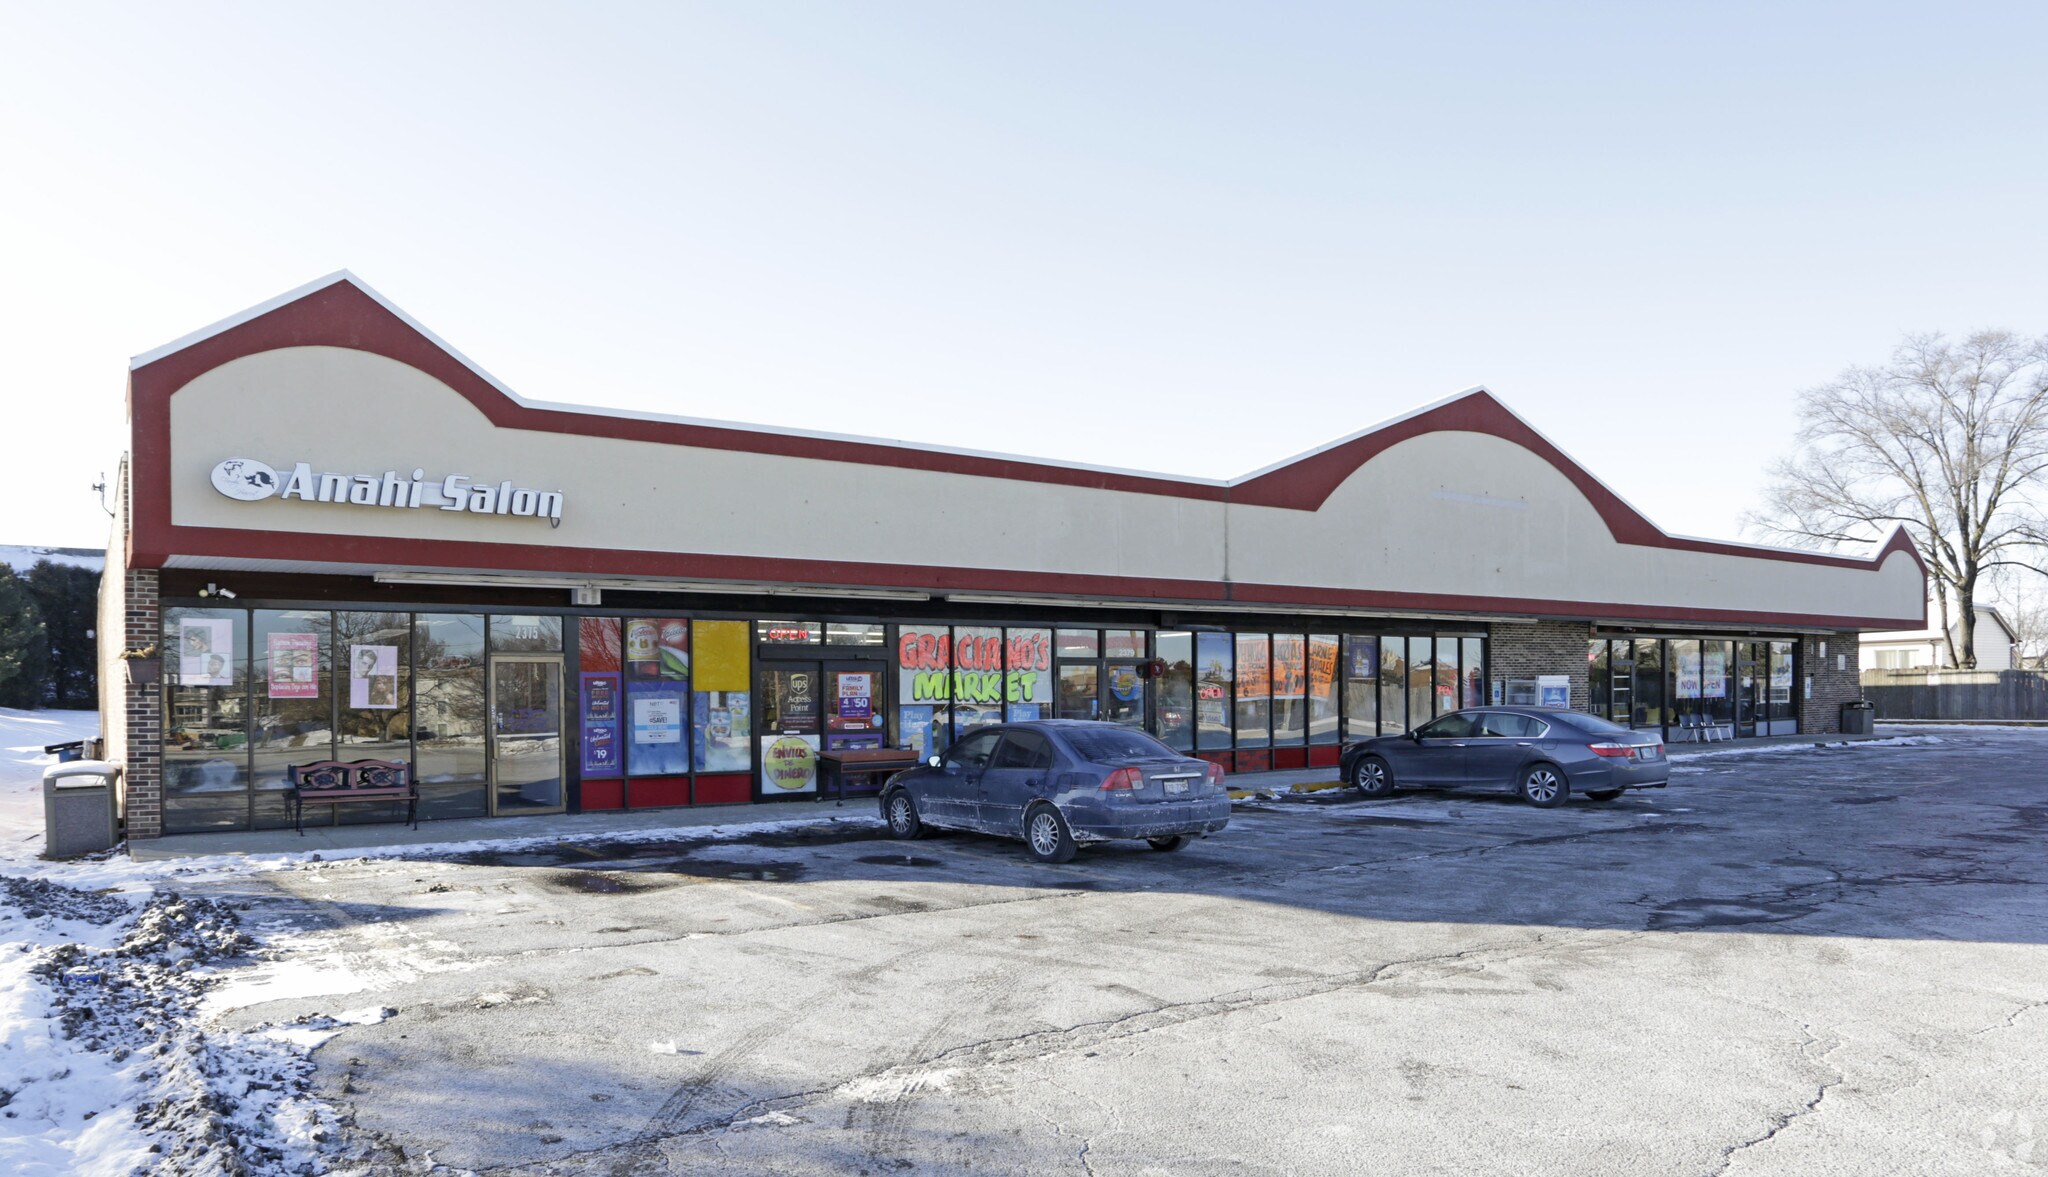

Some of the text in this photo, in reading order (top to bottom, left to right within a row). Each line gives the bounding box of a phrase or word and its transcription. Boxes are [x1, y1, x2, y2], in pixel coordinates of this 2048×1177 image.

[281, 462, 564, 518] Anahi Salon
[516, 626, 538, 639] 2375
[769, 628, 808, 639] OPEN
[899, 632, 1049, 671] GRACIANO'S
[1119, 648, 1135, 657] 2379
[913, 671, 1038, 704] MARKET
[1681, 680, 1697, 690] NOW
[1200, 687, 1224, 699] OPEN
[903, 710, 925, 721] Play
[1013, 708, 1032, 718] Play
[772, 745, 807, 759] ENVIOS
[773, 767, 811, 780] DINERO
